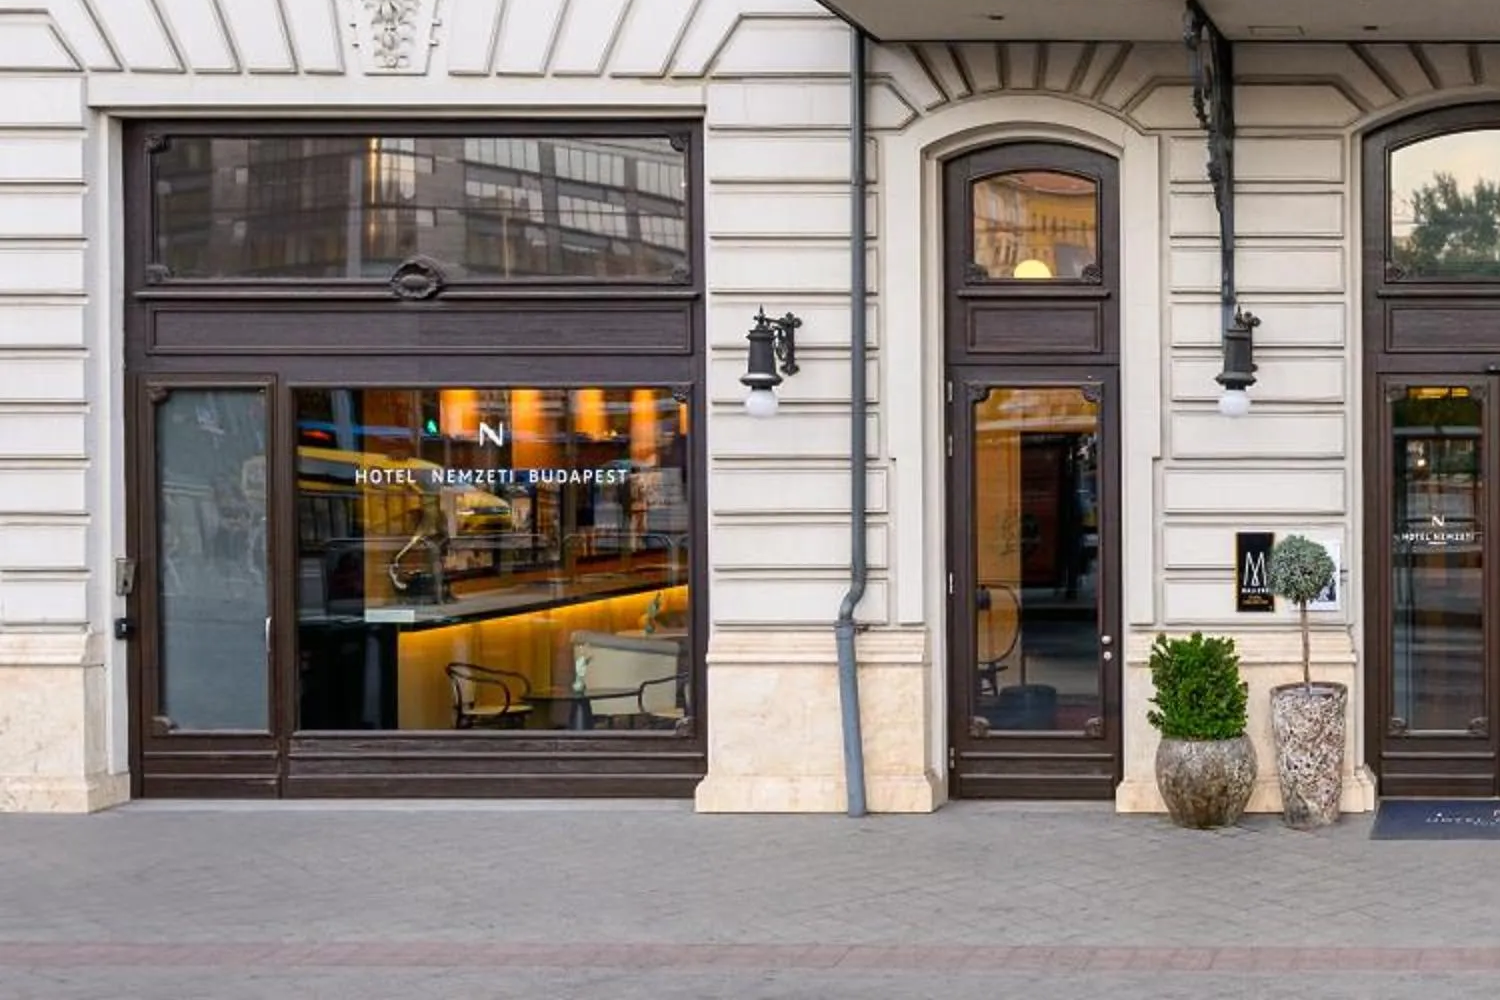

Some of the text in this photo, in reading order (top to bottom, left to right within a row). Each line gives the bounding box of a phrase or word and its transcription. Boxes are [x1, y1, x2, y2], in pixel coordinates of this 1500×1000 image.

[479, 421, 504, 448] N
[354, 468, 628, 485] HOTEL NEMZETI BUDAPEST
[1431, 514, 1445, 527] N
